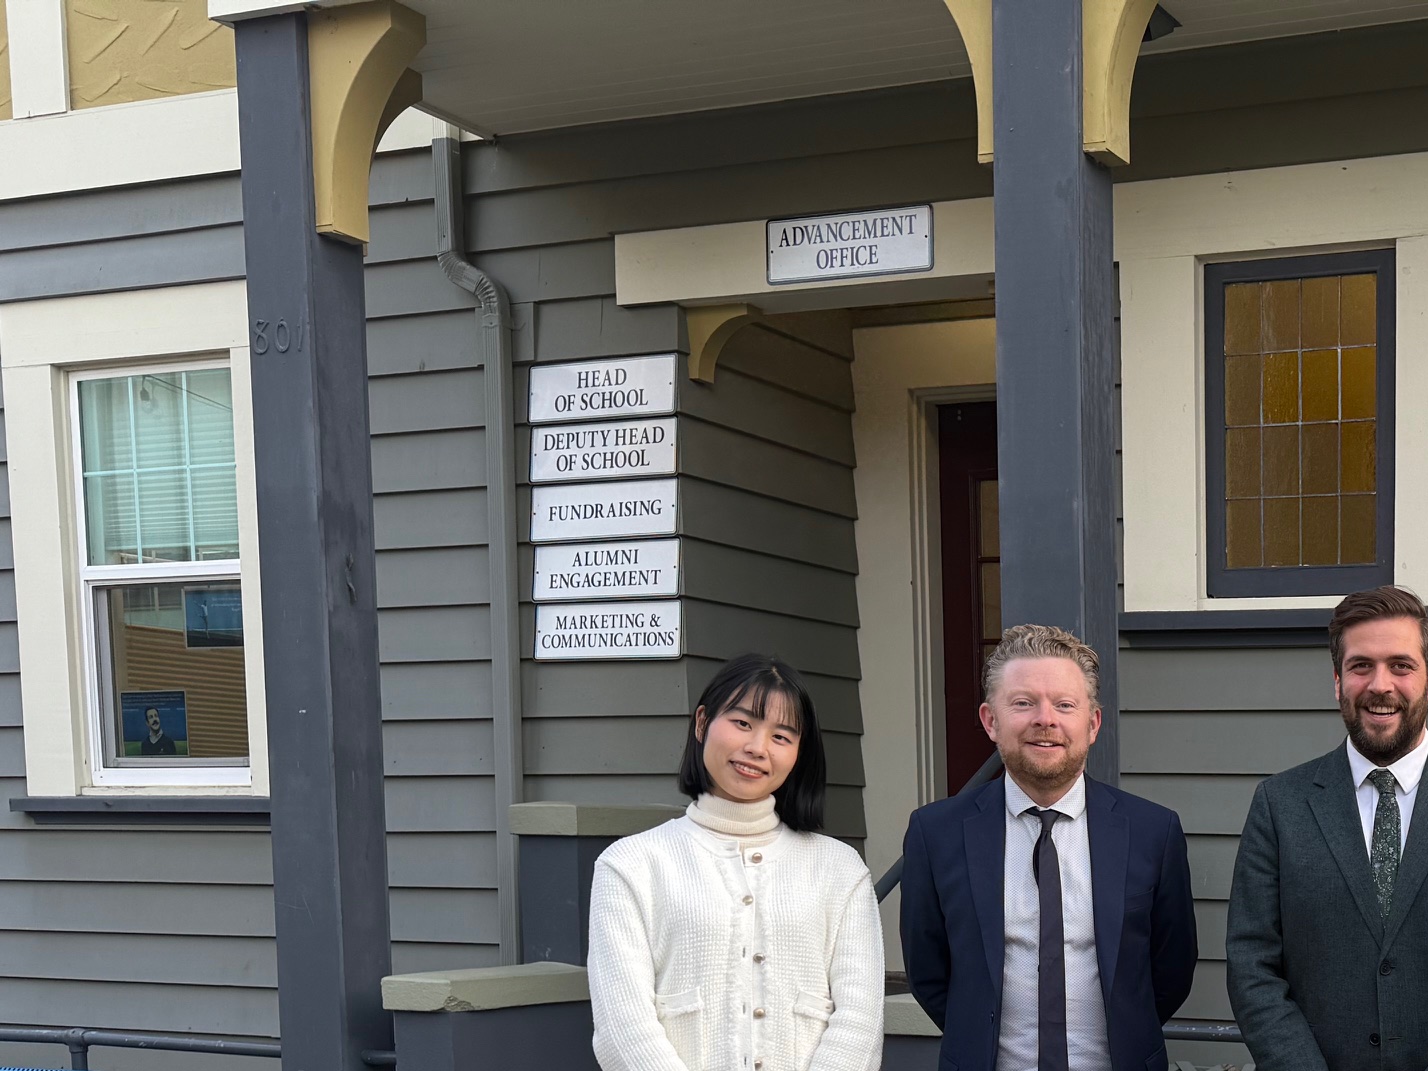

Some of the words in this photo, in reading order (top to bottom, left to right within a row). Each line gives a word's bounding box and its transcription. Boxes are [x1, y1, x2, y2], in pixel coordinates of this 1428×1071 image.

[778, 214, 917, 248] ADVANCEMENT
[816, 244, 879, 270] OFFICE
[253, 317, 304, 355] 801
[576, 368, 627, 389] HEAD
[554, 394, 576, 413] OF
[579, 388, 649, 411] SCHOOL
[543, 429, 611, 451] DEPUTY
[614, 426, 665, 446] HEAD
[556, 454, 577, 472] OF
[581, 449, 650, 470] SCHOOL
[548, 499, 662, 522] FUNDRAISING
[572, 548, 639, 568] ALUMNI
[549, 569, 661, 589] ENGAGEMENT
[555, 613, 645, 630] MARKETING
[649, 613, 661, 628] &
[541, 631, 675, 649] COMMUNICATIONS
